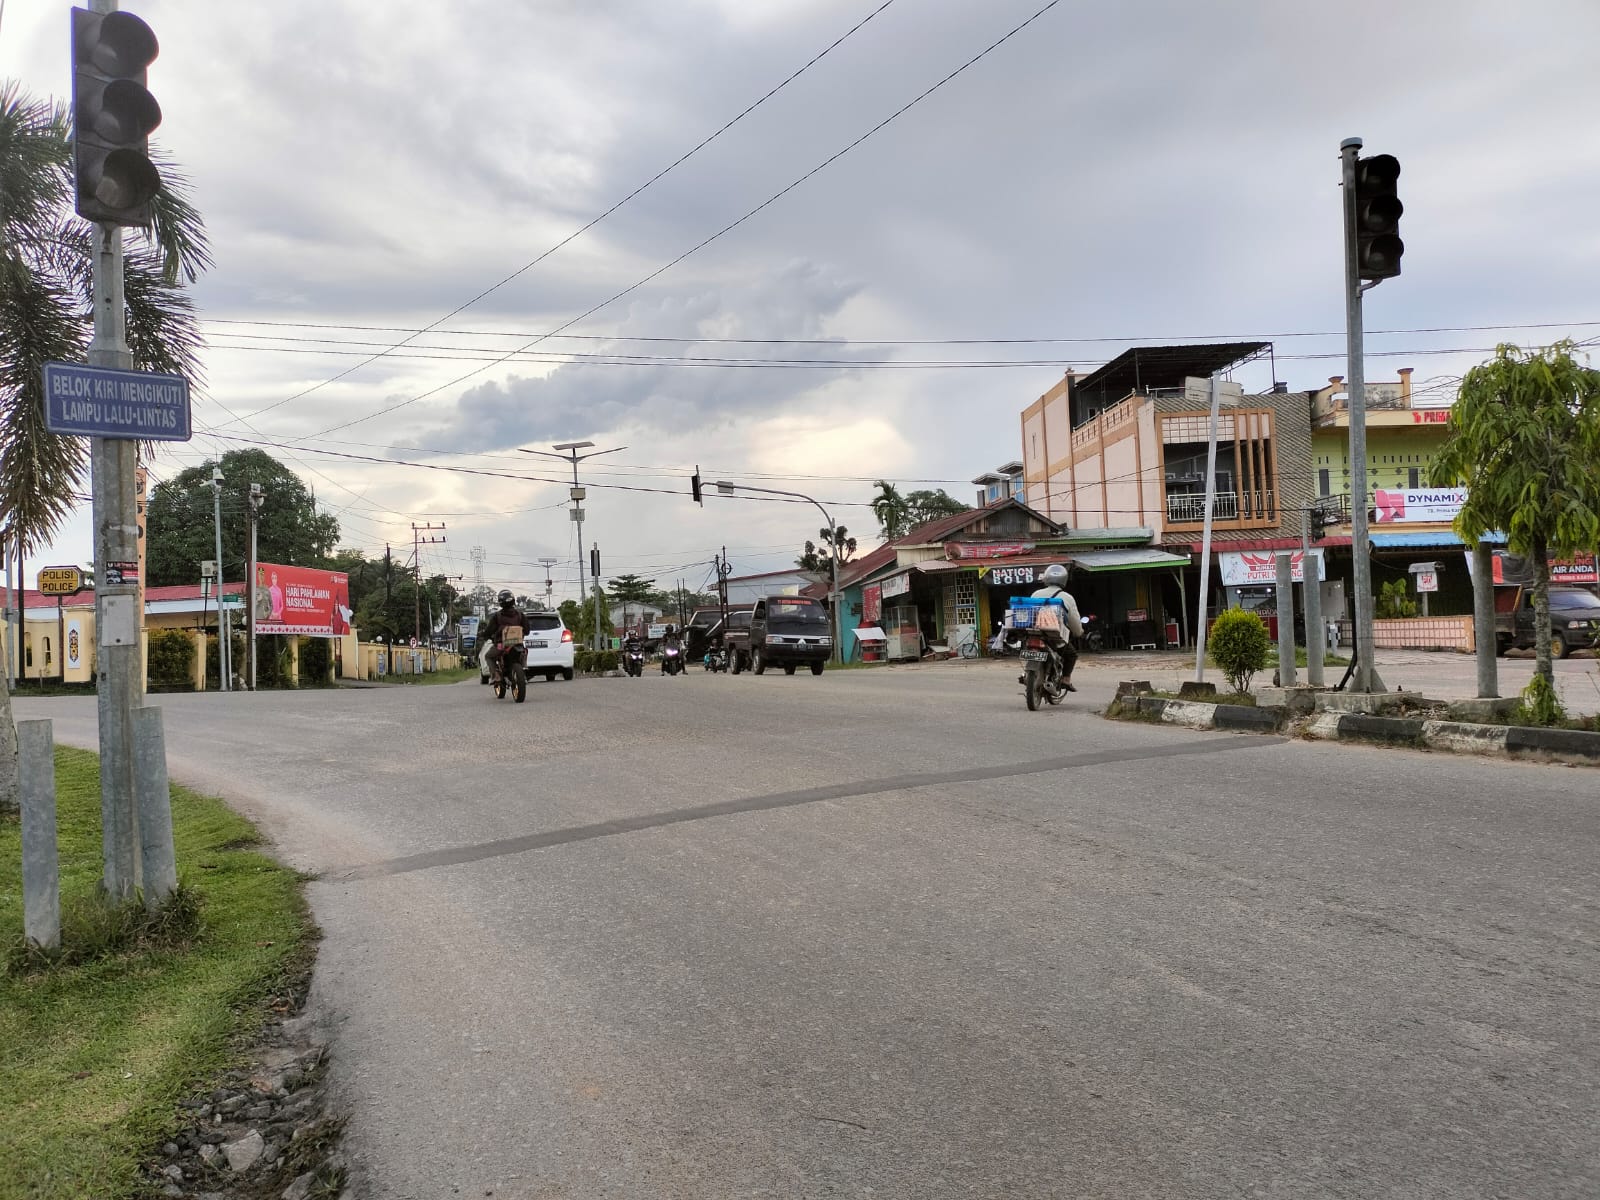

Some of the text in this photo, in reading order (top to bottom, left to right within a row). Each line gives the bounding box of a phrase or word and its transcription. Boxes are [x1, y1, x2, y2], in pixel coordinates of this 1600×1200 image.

[53, 375, 182, 405] BELOK KIRI MENGIKUTI
[62, 400, 177, 428] LAMPU LALU-LINTAS
[1408, 493, 1464, 503] DYNAMIX
[992, 567, 1034, 577] NATION
[1553, 565, 1593, 573] AIR ANDA
[42, 570, 74, 579] POLISI
[1247, 571, 1270, 579] PUTRI
[993, 575, 1034, 585] BOLD
[42, 582, 73, 591] POLICE
[285, 586, 330, 599] HARI PAHLAWAN
[285, 597, 314, 608] NASIONAL
